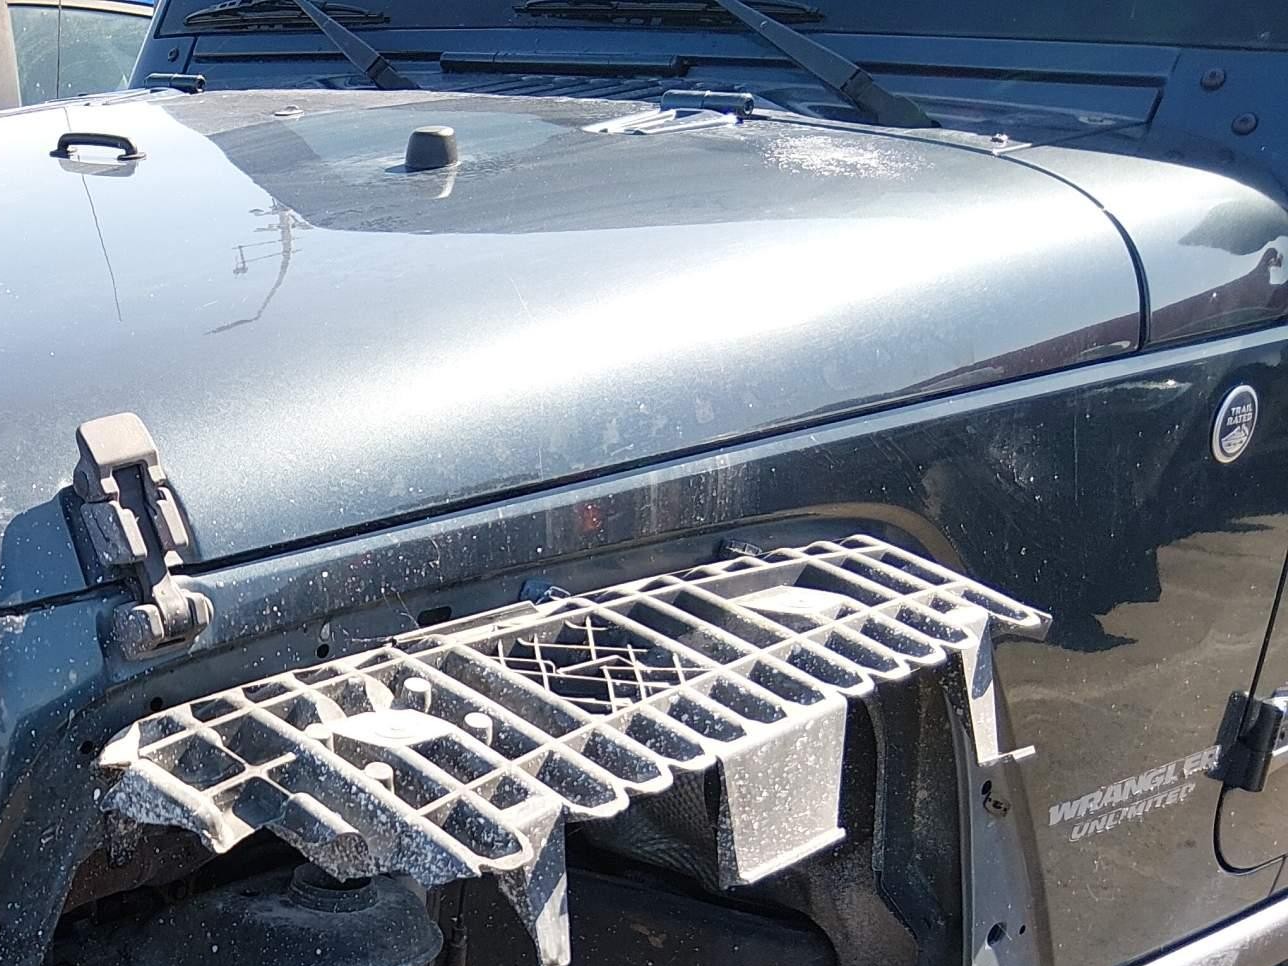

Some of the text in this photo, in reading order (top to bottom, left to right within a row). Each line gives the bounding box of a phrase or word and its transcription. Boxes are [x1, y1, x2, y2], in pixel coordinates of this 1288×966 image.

[1226, 413, 1253, 427] RATED
[1230, 403, 1253, 417] TRAIL
[1049, 745, 1222, 826] WRANGLER
[1068, 783, 1197, 842] UNLIMITED
